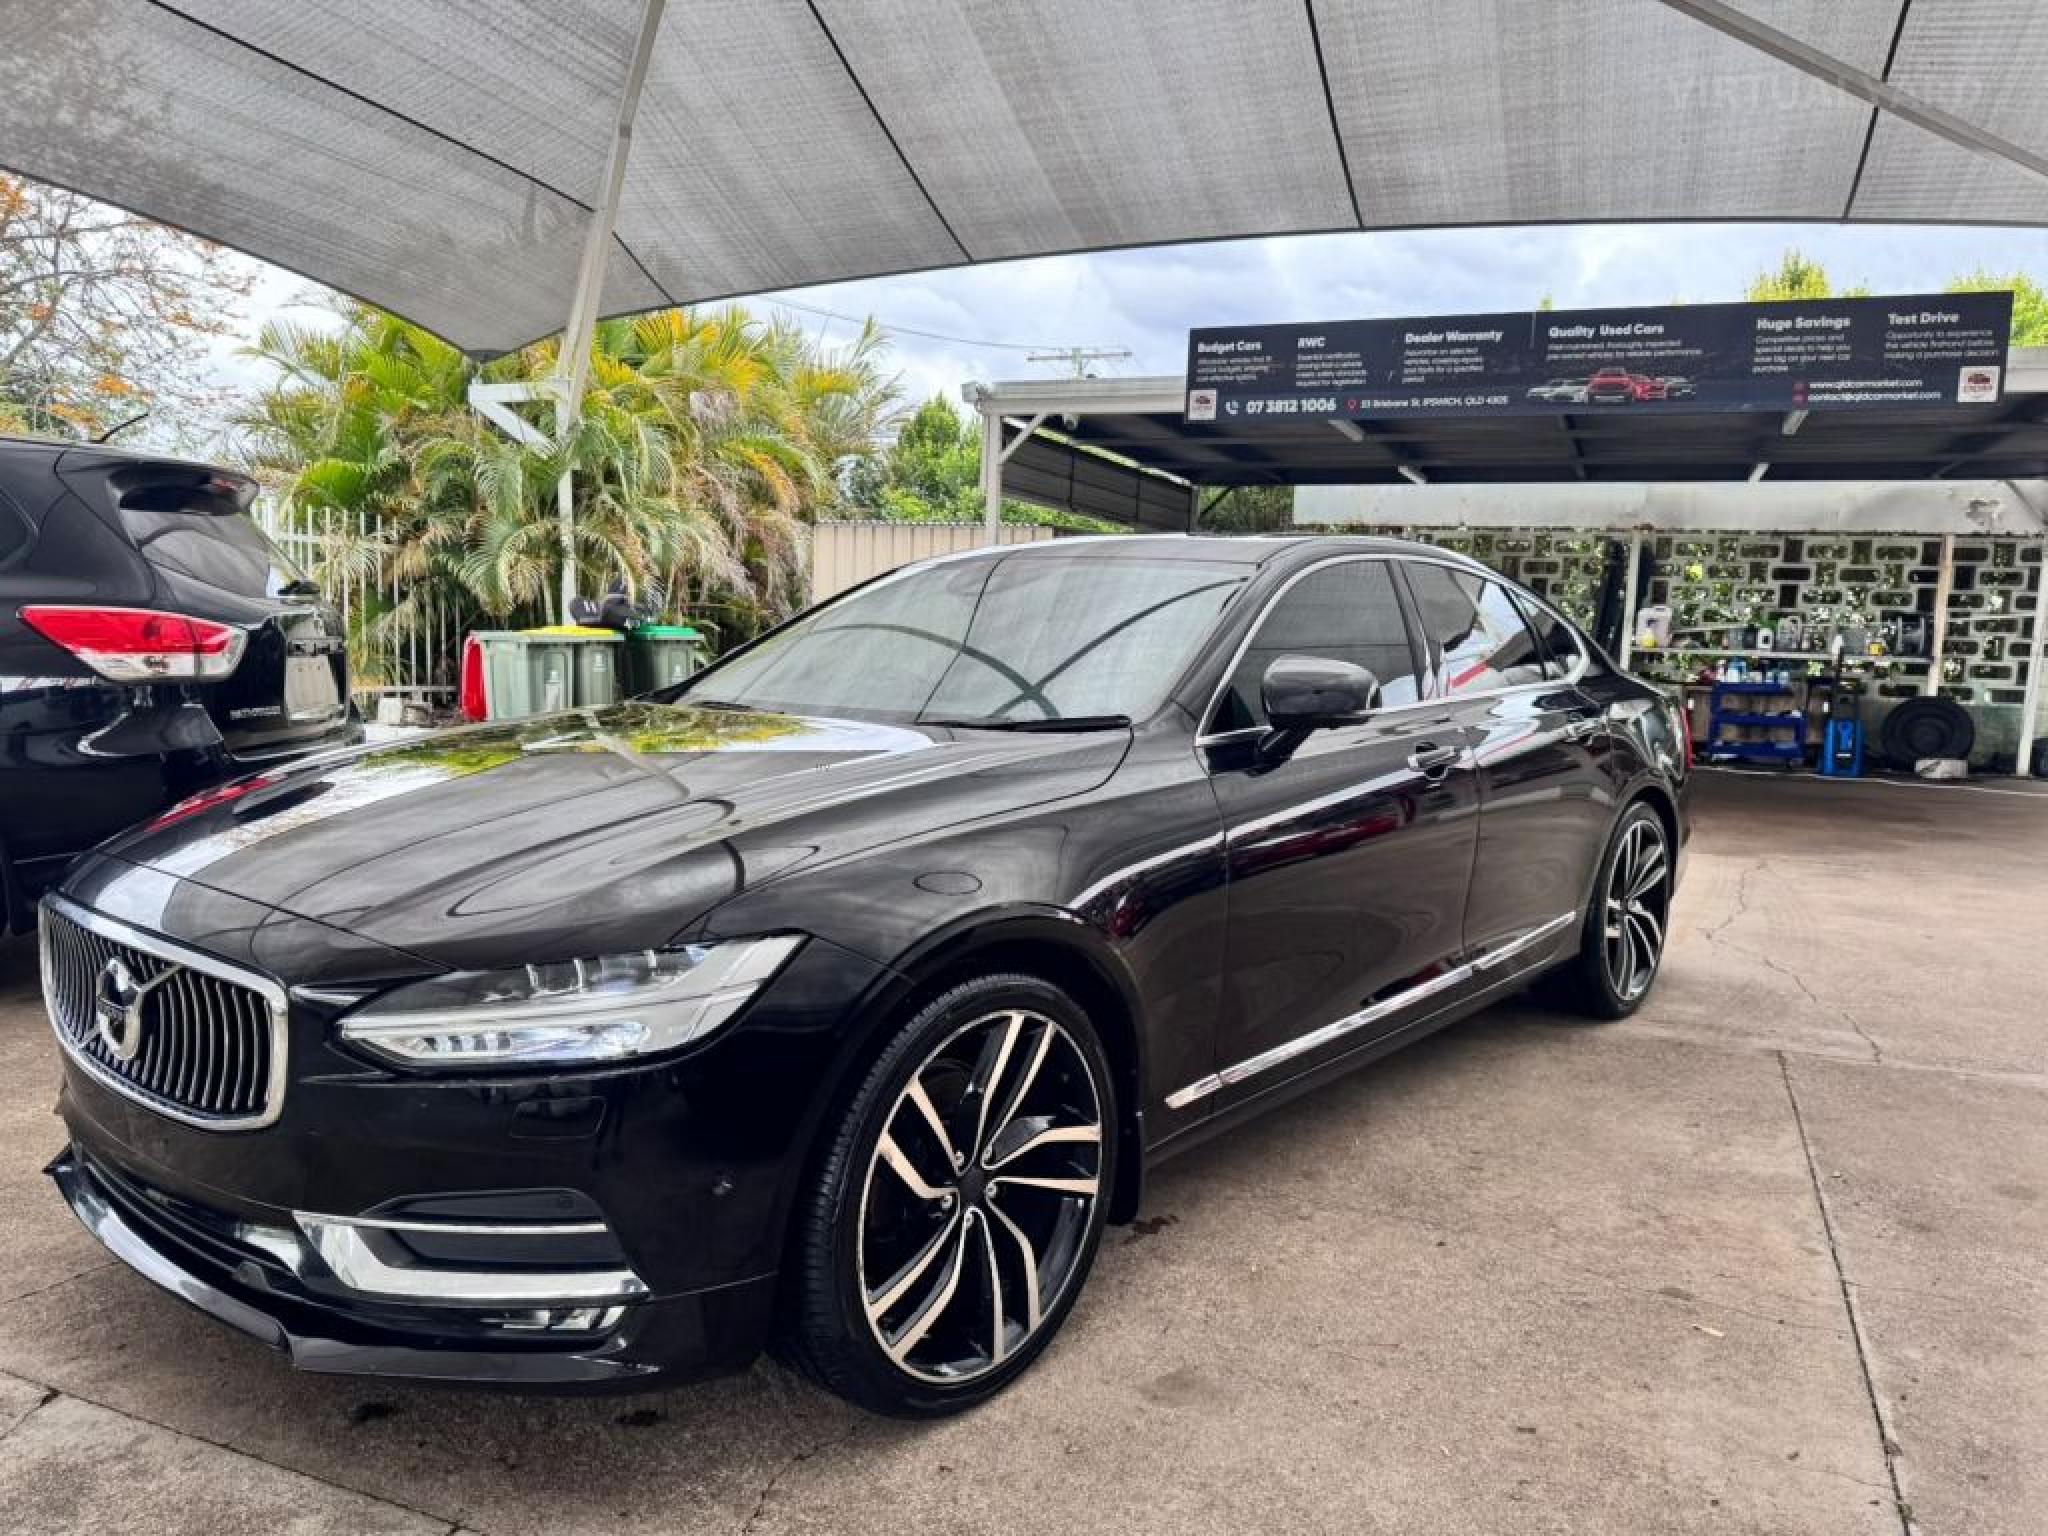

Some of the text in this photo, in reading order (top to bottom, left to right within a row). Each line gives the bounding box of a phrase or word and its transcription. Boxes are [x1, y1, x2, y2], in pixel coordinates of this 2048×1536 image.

[1756, 316, 1851, 332] Huge Savings
[1888, 312, 1960, 324] Test Drive
[1404, 330, 1503, 343] Dealer Warranty
[1548, 323, 1664, 338] Quality Used Cars
[1197, 340, 1262, 354] Budget Cars
[1297, 336, 1326, 348] RWC
[1246, 397, 1337, 414] 07 3812 1006
